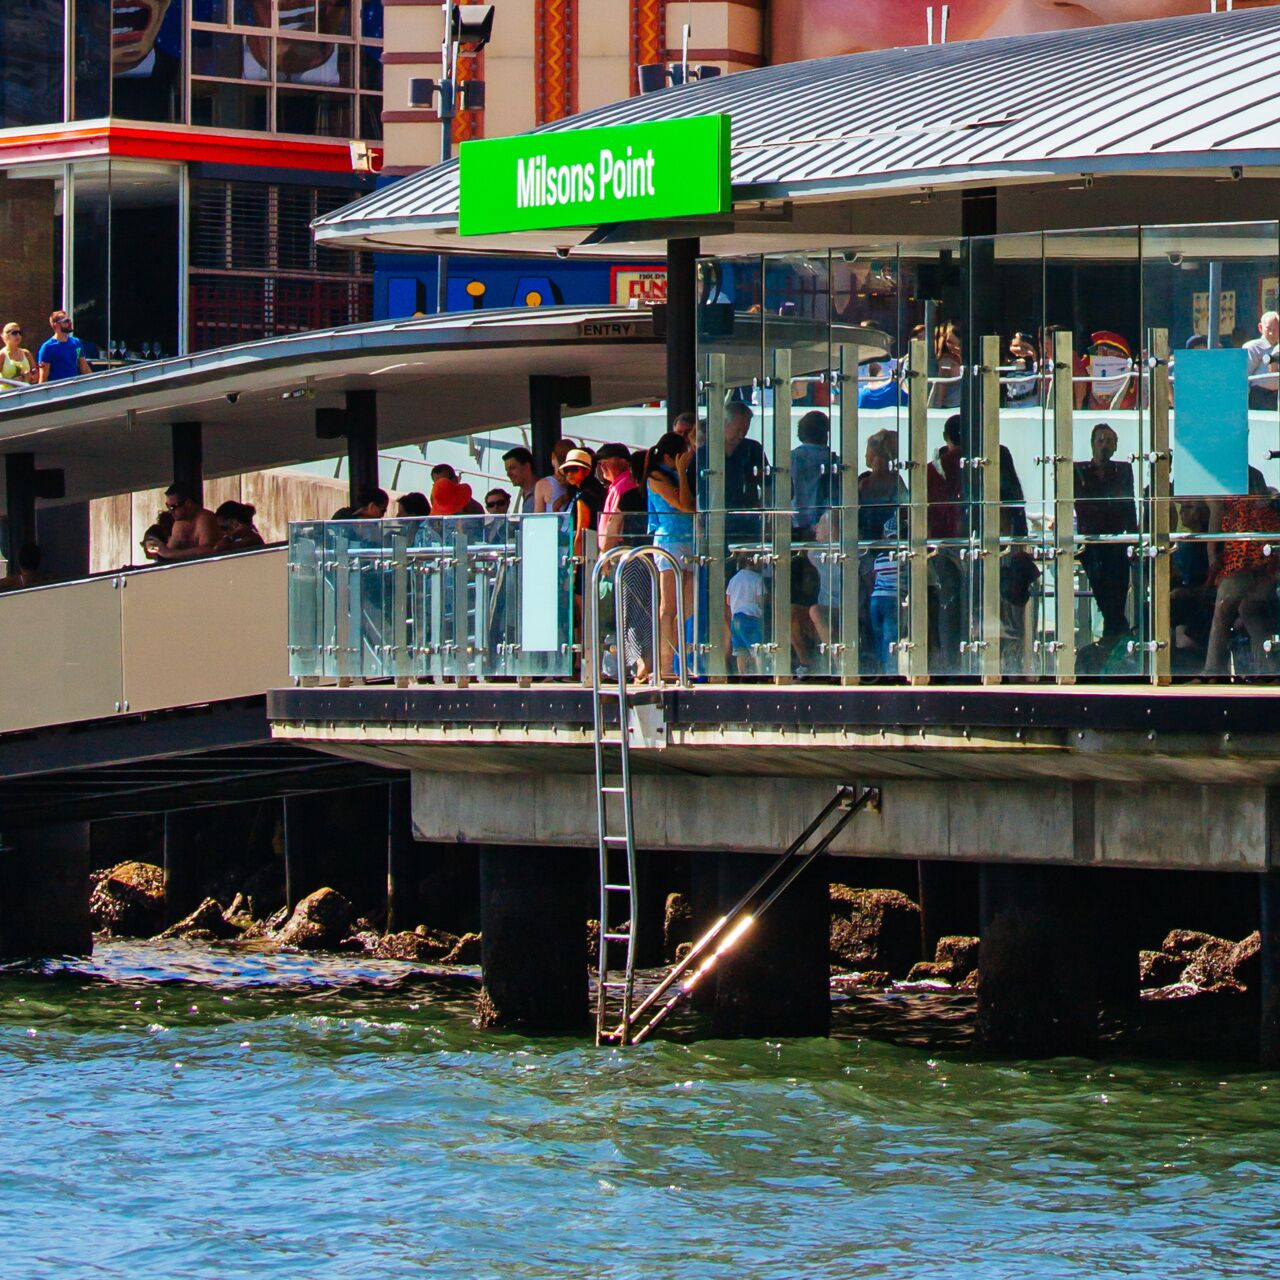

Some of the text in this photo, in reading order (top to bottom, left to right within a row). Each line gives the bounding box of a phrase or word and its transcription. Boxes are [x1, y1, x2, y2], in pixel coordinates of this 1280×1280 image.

[517, 145, 655, 208] Milsons Point
[583, 322, 632, 337] ENTRY
